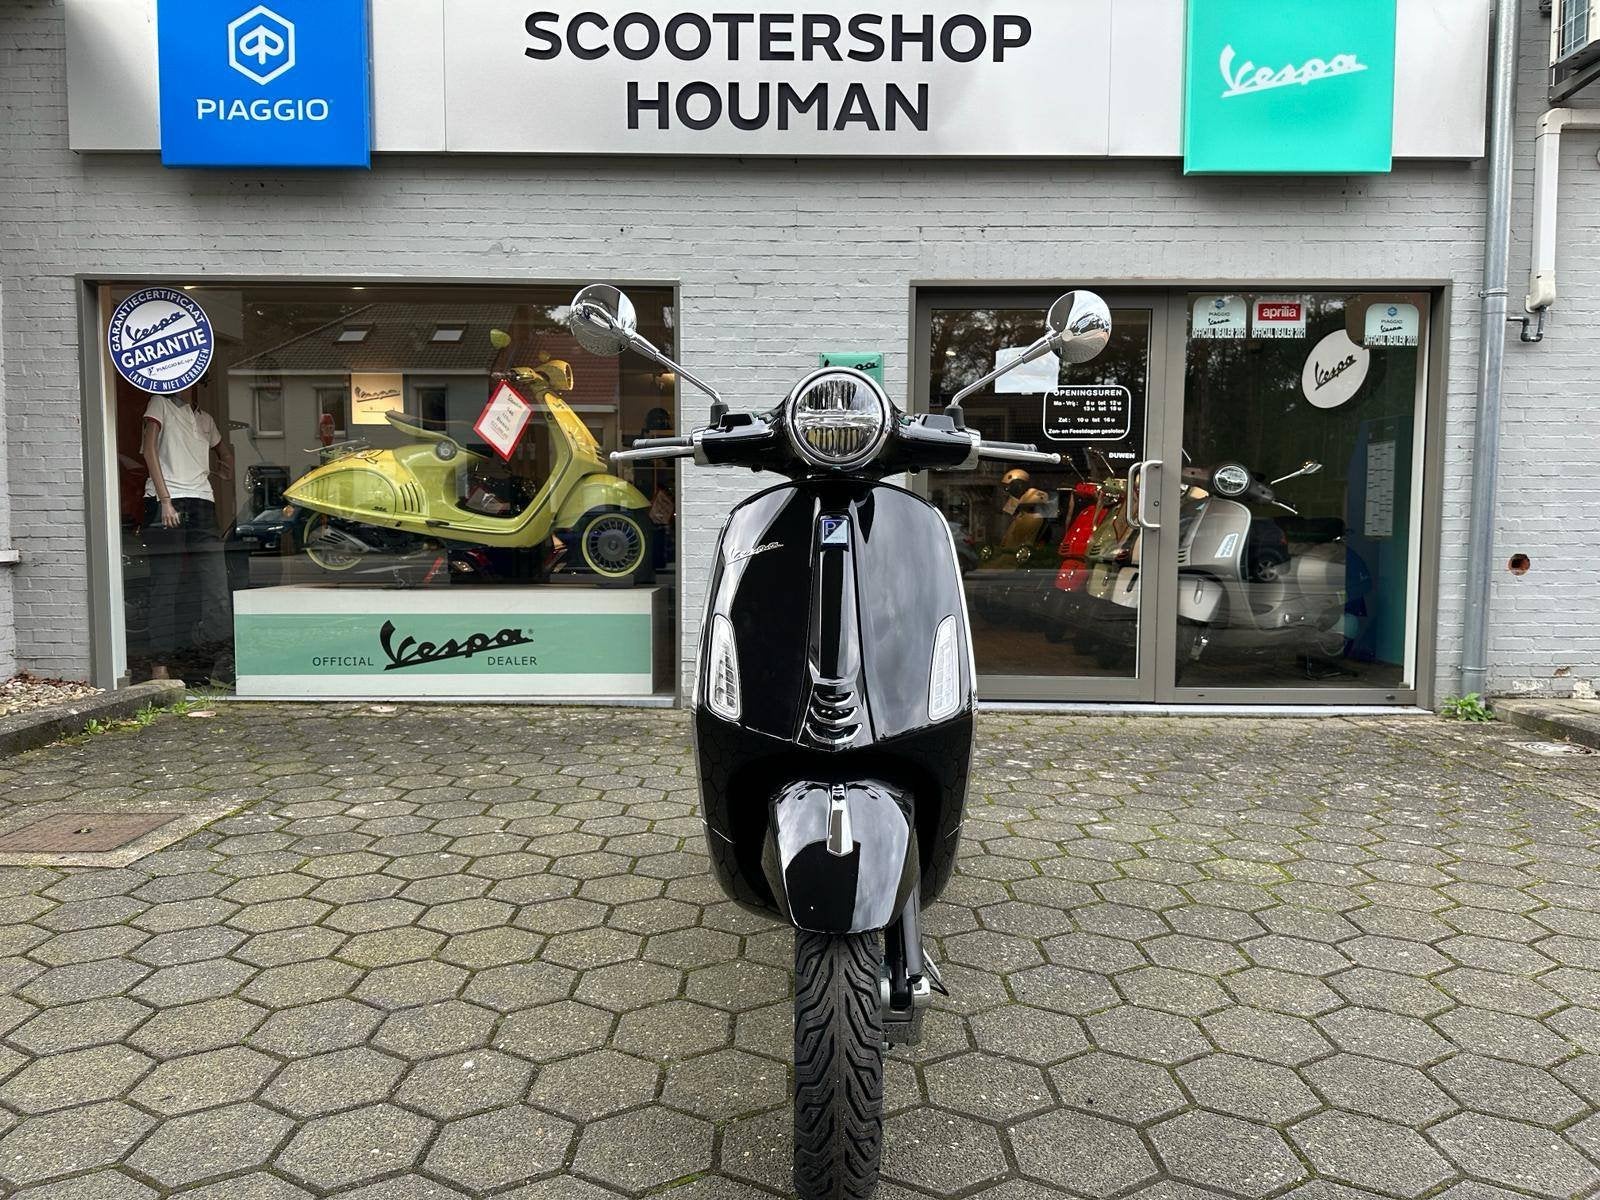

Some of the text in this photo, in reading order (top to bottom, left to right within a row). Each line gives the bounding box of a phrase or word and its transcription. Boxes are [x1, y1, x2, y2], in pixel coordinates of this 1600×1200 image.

[524, 11, 1032, 63] SCOOTERSHOP
[1219, 44, 1368, 98] Vespa
[197, 98, 329, 121] PIAGGIO
[626, 81, 929, 131] HOUMAN
[112, 290, 205, 352] GARANTIECERTIFICAAT
[125, 312, 186, 346] Vespa
[1262, 305, 1297, 319] aprilia
[121, 329, 207, 368] GARANTIE
[1192, 328, 1214, 338] OFFICIAL
[1215, 328, 1234, 338] DEALER
[1252, 328, 1273, 338] OFFICIAL
[1274, 328, 1294, 338] DEALER
[1364, 335, 1386, 346] OFFICIAL
[1387, 335, 1406, 346] DEALER
[128, 349, 210, 391] LAAT JE NIET VERRASSEN
[1315, 354, 1358, 391] Vespa
[1053, 389, 1123, 397] OPENINGSUREN
[312, 620, 538, 671] OFFICIAL Vespa DEALER
